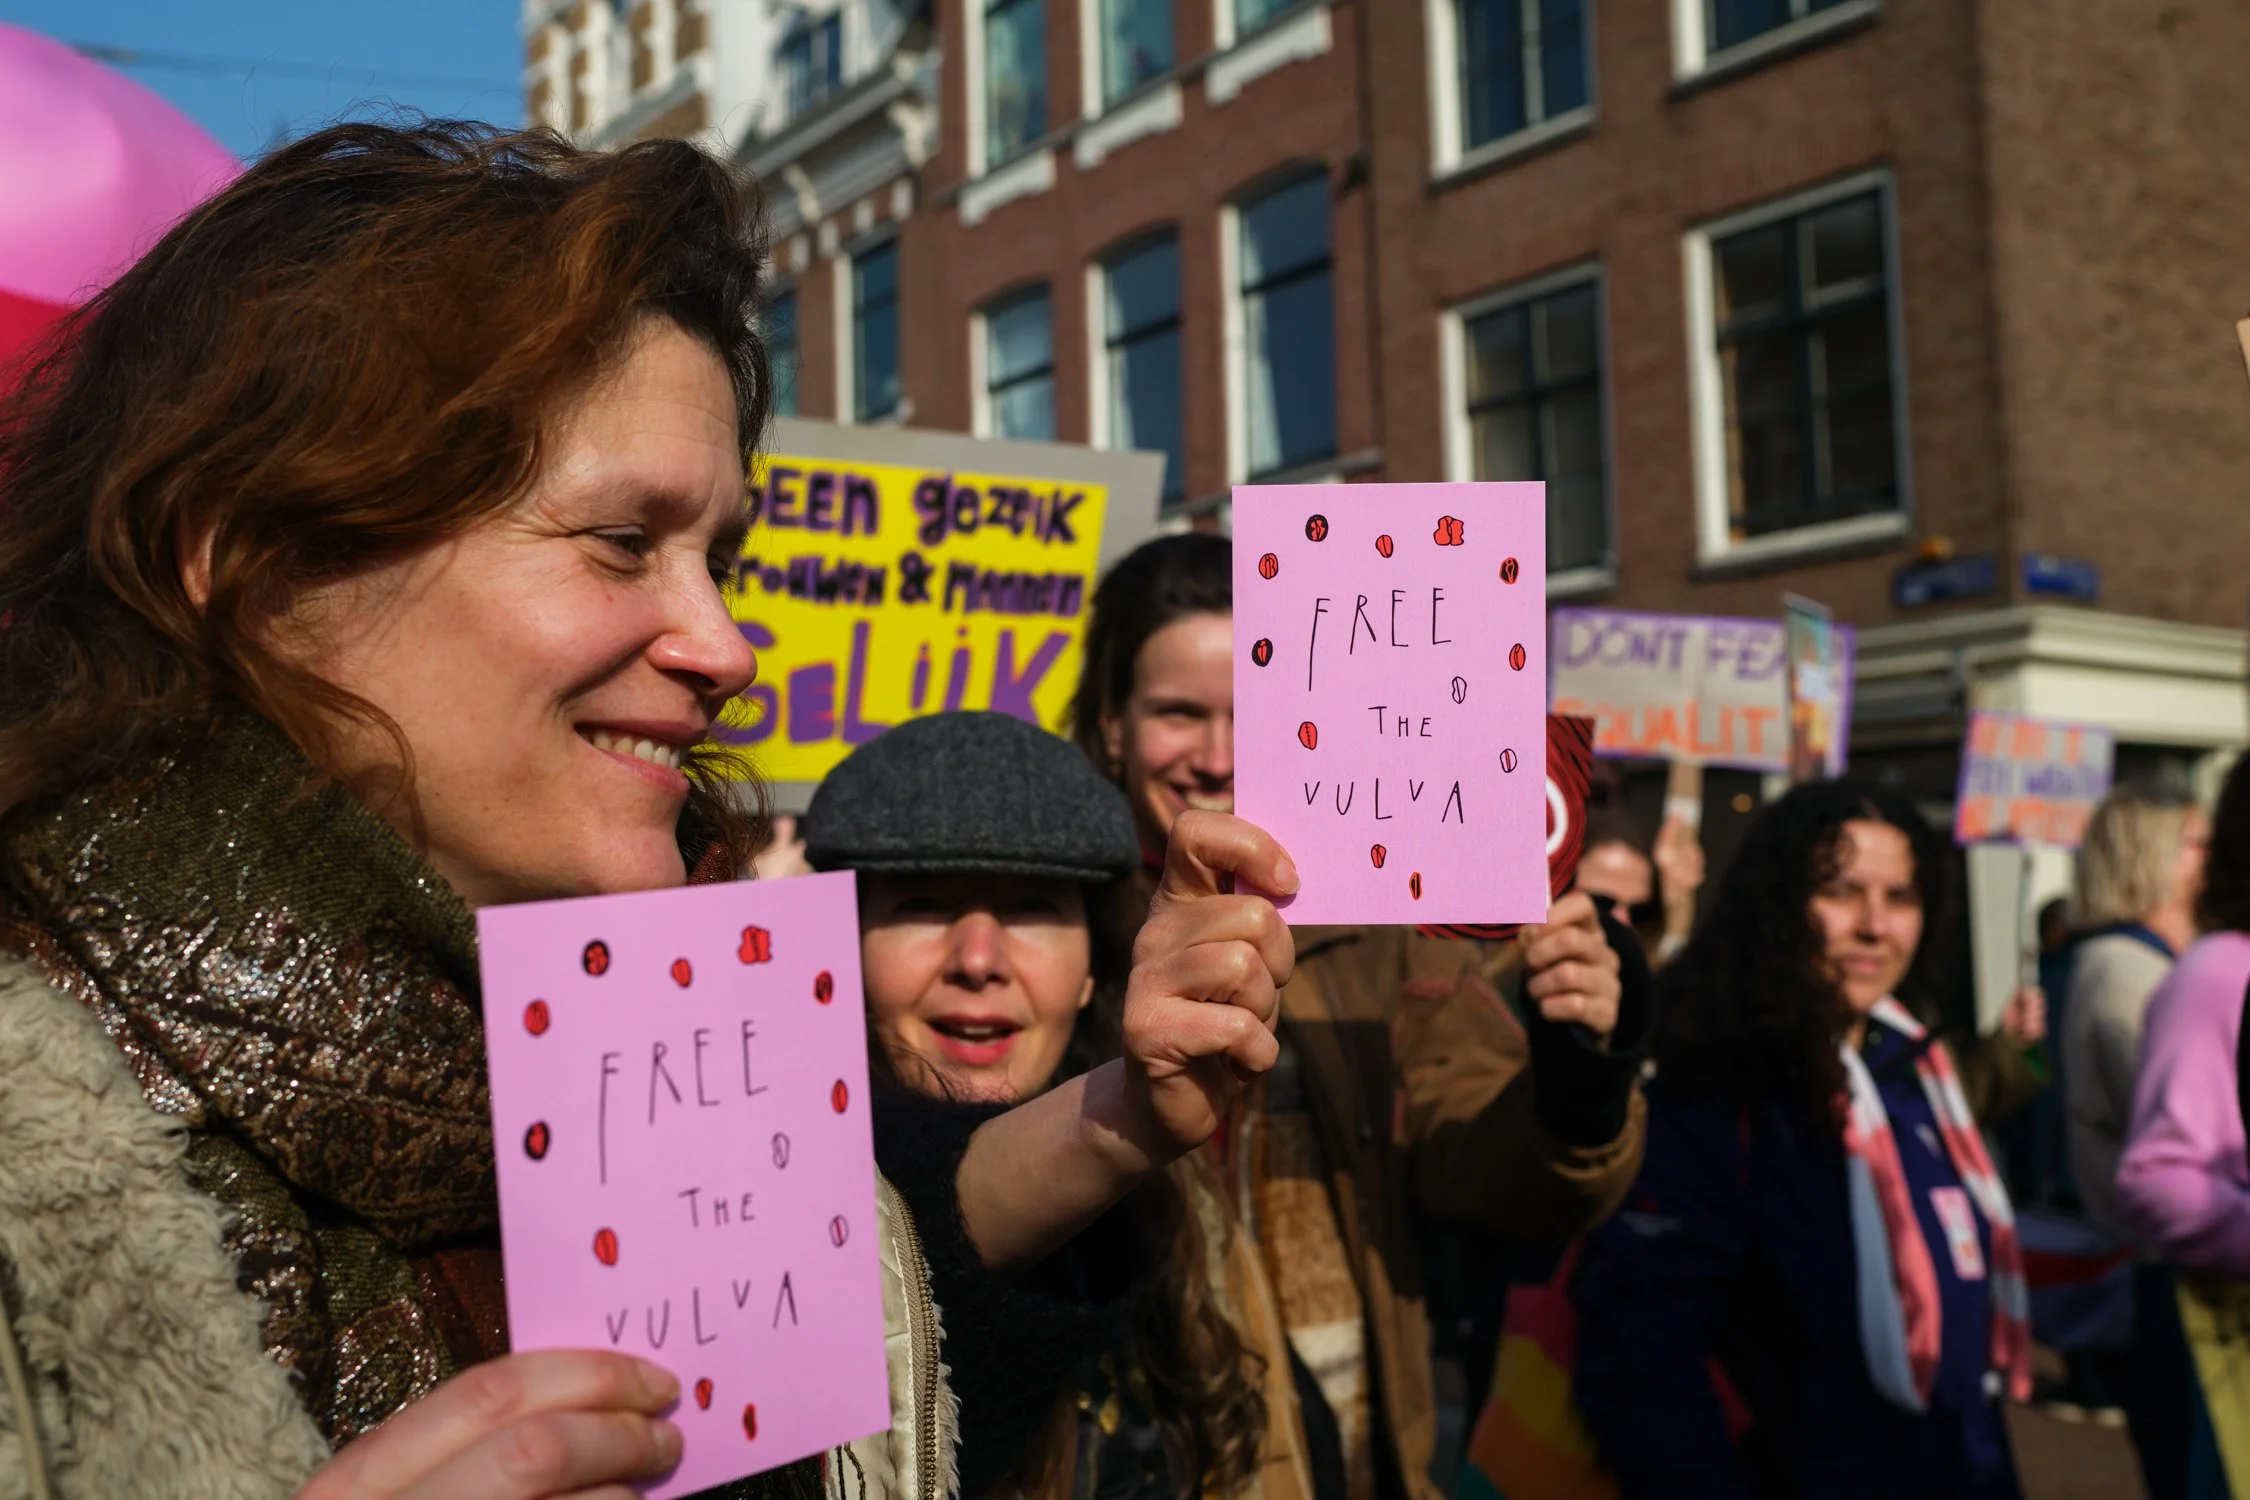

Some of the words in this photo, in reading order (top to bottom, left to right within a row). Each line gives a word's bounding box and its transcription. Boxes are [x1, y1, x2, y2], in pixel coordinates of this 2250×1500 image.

[899, 552, 934, 604] &
[1308, 587, 1452, 692] FREE
[1704, 628, 1790, 682] FEA
[1368, 705, 1433, 738] THE
[1553, 698, 1790, 763] QUALIT
[1304, 777, 1464, 824] VULVA
[597, 1019, 769, 1186] FREE
[678, 1187, 757, 1228] THE
[605, 1270, 798, 1350] VULVA
